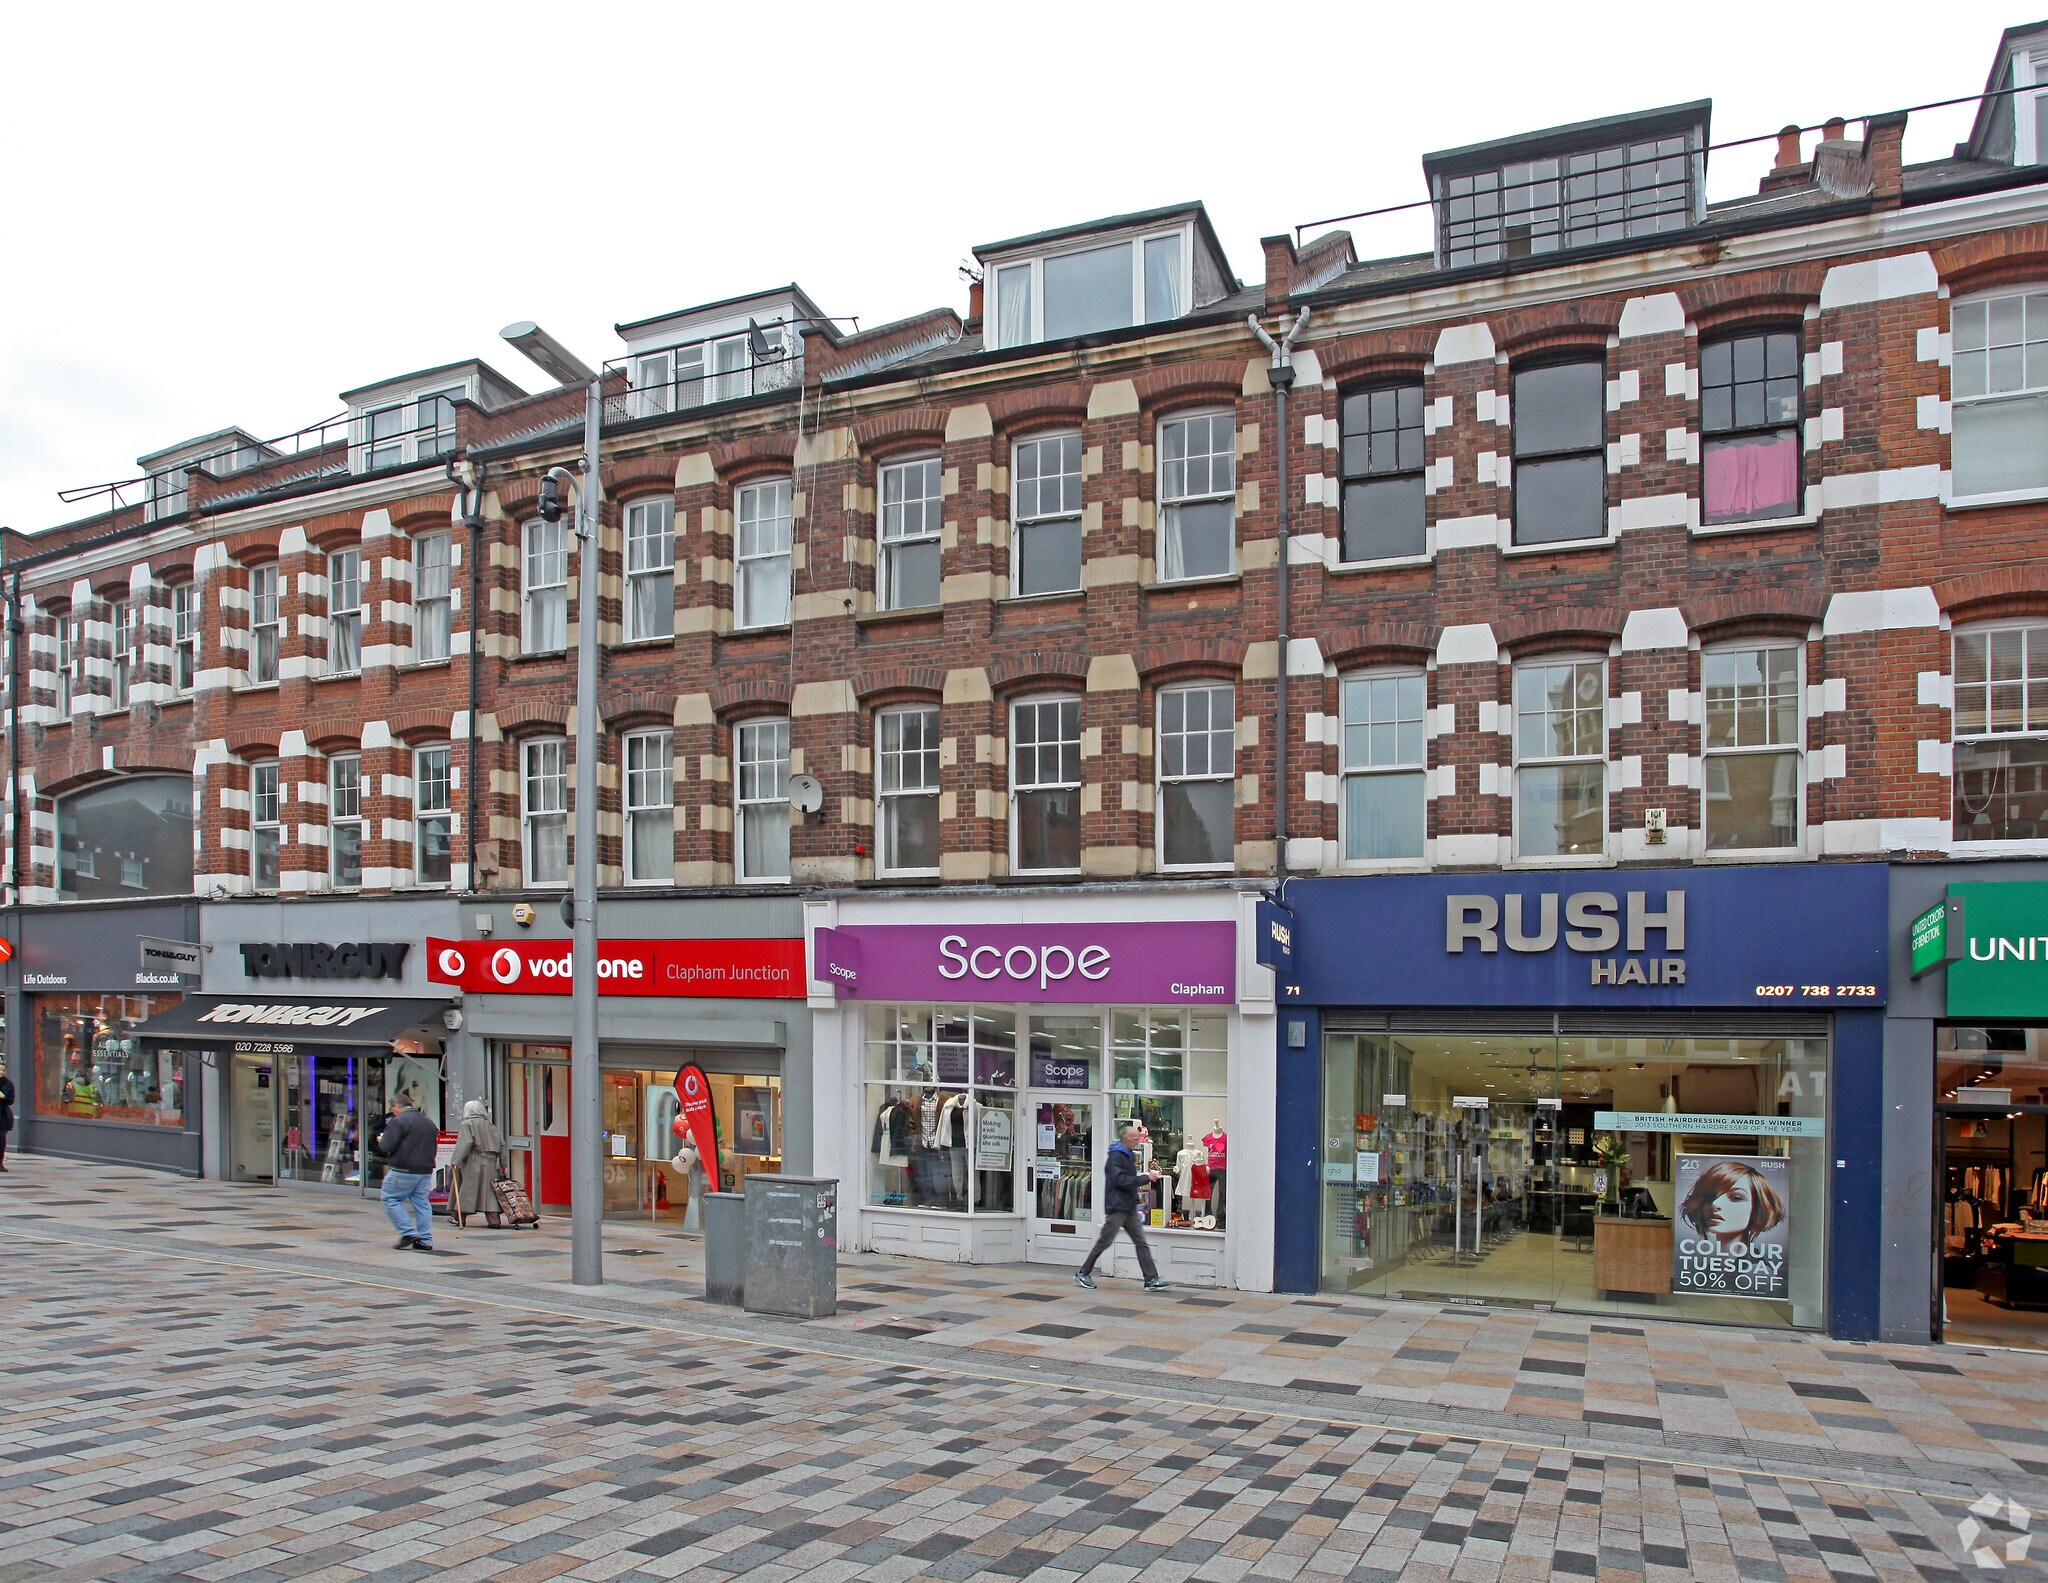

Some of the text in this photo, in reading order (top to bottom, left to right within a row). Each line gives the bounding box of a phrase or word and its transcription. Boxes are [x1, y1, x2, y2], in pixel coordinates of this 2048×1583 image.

[1446, 890, 1685, 953] RUSH
[1912, 905, 1945, 936] UNITED COLORS
[1271, 920, 1291, 946] RUSH
[144, 948, 197, 962] TONI&GUY
[239, 942, 410, 979] TONI&GUY
[937, 935, 1112, 990] Scope
[528, 952, 643, 979] vodone
[829, 962, 857, 980] Scope
[1591, 958, 1686, 985] HAIR
[23, 974, 67, 985] Life Outdoors
[135, 973, 180, 985] Blacks.co.uk
[666, 964, 790, 983] Clapham Junction
[1170, 982, 1225, 998] Clapham
[1285, 986, 1300, 996] 71
[1755, 985, 1876, 996] 0207 738 2733
[197, 1003, 389, 1026] TONI&GUY
[93, 1050, 129, 1058] ESSENTIALS
[235, 1042, 294, 1053] 020 7228 5566
[1045, 1064, 1084, 1078] Scope
[1061, 1078, 1084, 1087] disability
[983, 1120, 1001, 1128] Making
[1695, 1123, 1748, 1131] HAIRDRESSER
[1328, 1167, 1341, 1176] ghd
[1680, 1158, 1700, 1170] 20
[1760, 1161, 1785, 1169] RUSH
[1679, 1238, 1783, 1260] COLOUR
[1679, 1256, 1783, 1275] TUESDAY
[1679, 1271, 1726, 1288] 50%
[1735, 1274, 1783, 1291] OFF
